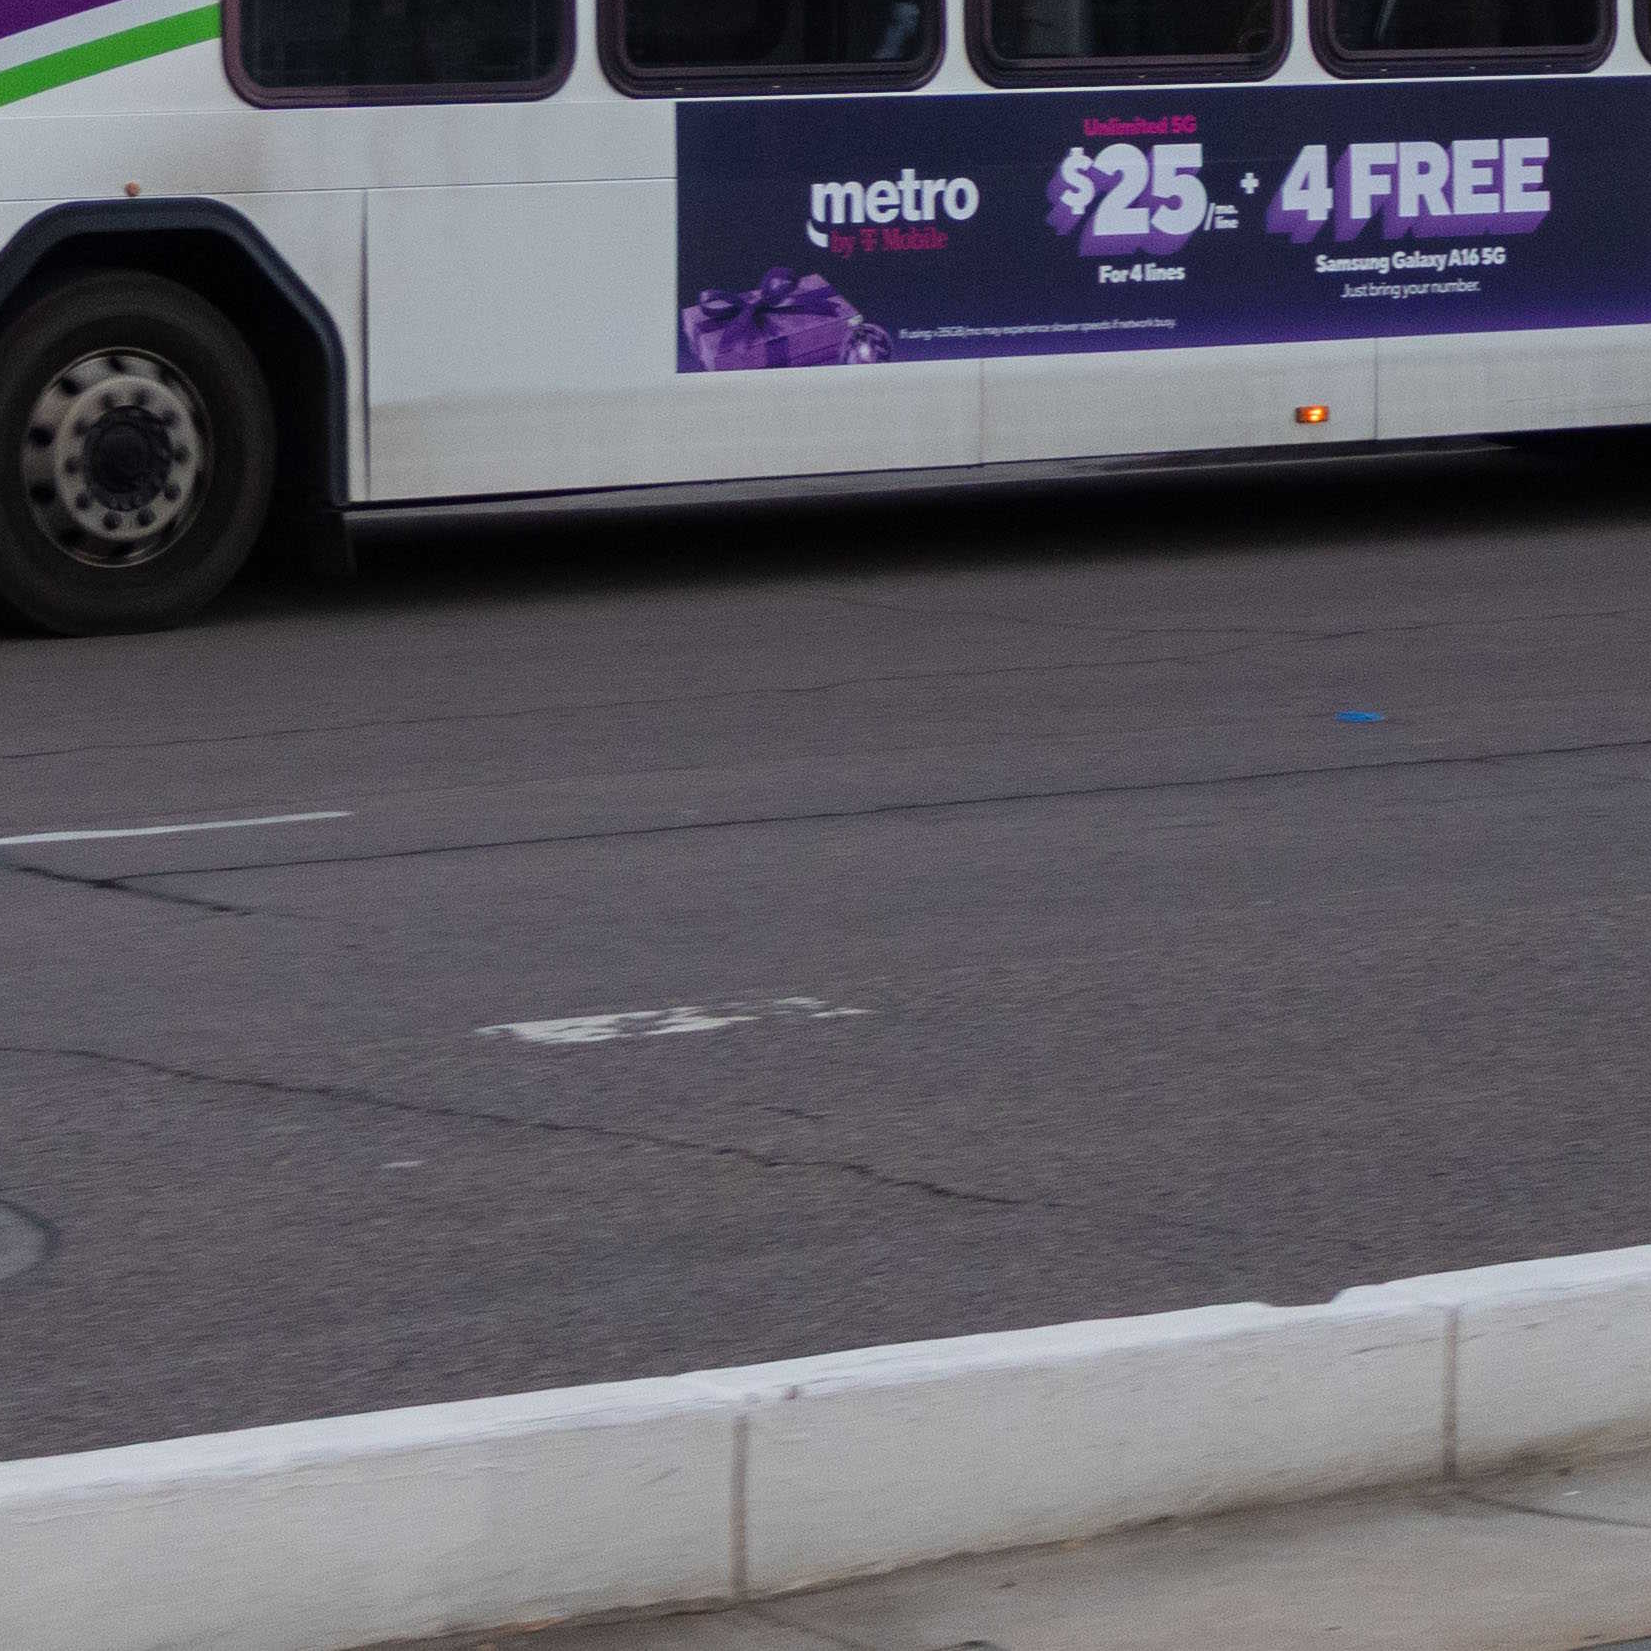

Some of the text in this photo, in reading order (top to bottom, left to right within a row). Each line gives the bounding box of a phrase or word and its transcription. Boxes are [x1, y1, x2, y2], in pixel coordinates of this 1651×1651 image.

[1084, 114, 1197, 136] Unlimited 5G
[1059, 143, 1208, 236] $25
[1281, 136, 1551, 222] 4 FREE
[807, 168, 980, 248] metro
[1099, 262, 1186, 284] For 4 lines
[1315, 246, 1507, 275] Samsung Galaxy A16 5G
[1340, 278, 1482, 299] Just bring your number.
